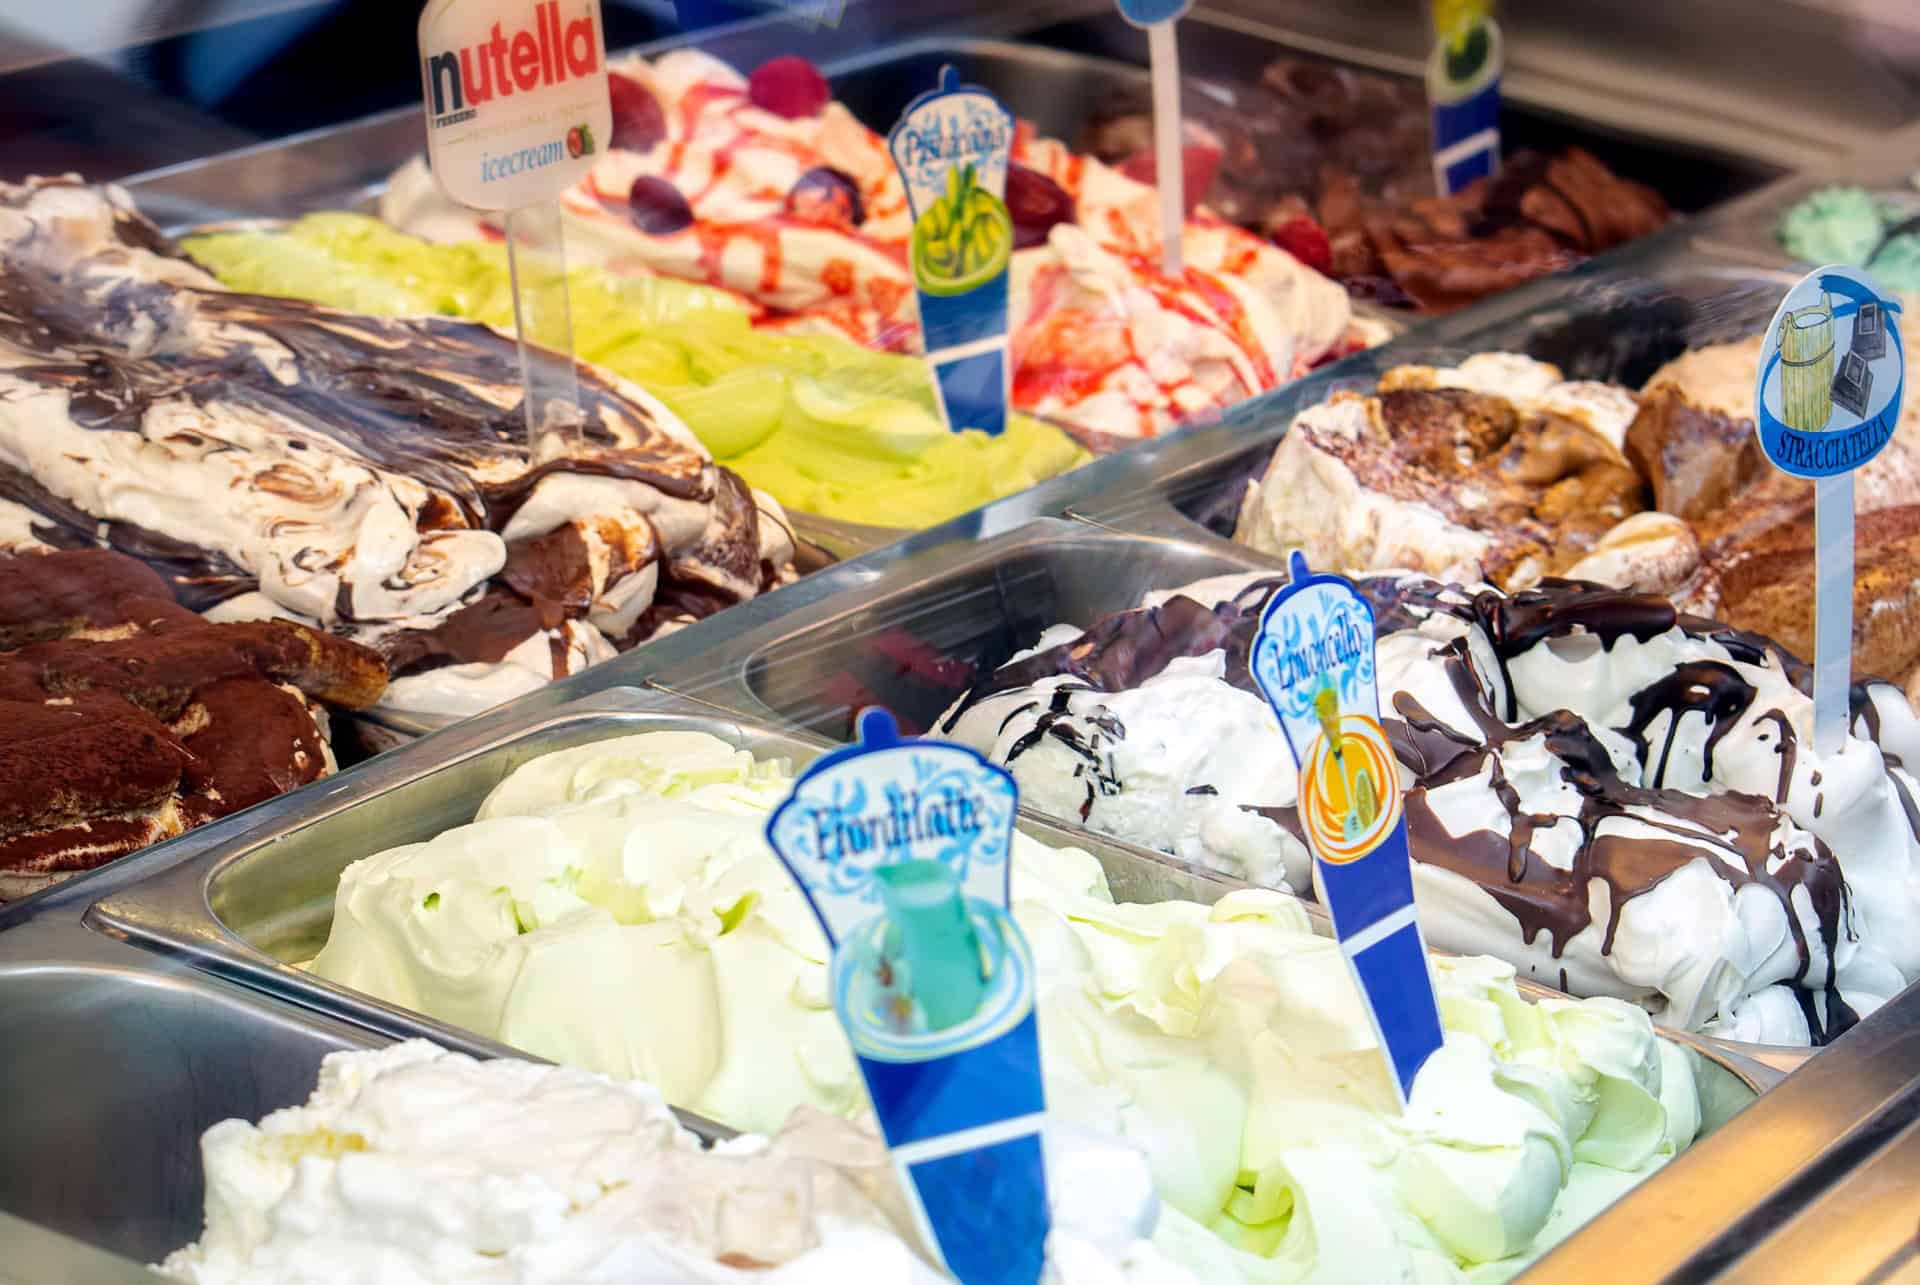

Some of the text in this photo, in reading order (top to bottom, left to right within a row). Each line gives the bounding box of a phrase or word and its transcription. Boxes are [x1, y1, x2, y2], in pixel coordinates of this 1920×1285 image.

[429, 0, 598, 115] nutella
[480, 140, 564, 182] icecream
[1776, 414, 1889, 469] STRACCIATELLA
